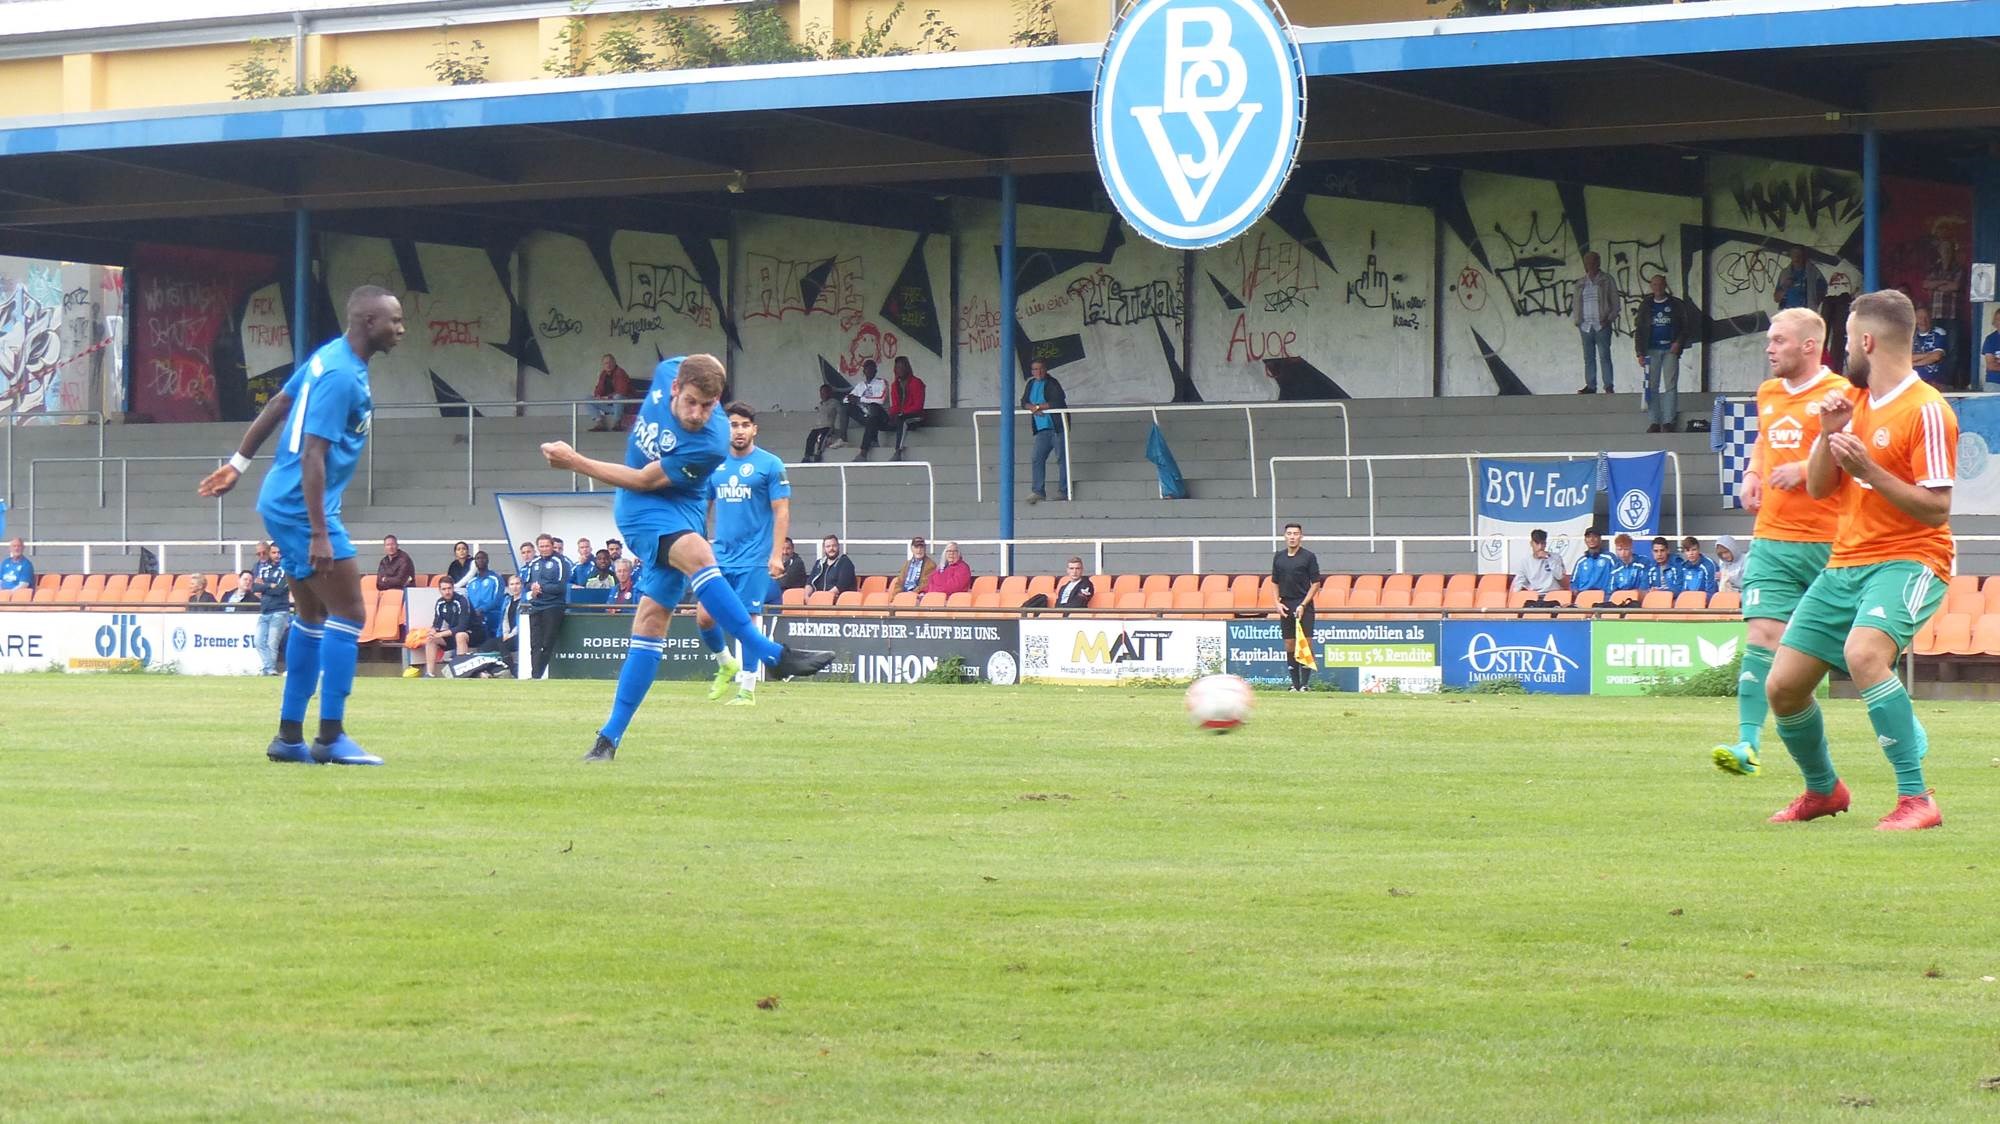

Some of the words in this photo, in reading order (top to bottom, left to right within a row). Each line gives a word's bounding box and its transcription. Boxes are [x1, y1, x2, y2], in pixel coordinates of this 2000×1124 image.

[1768, 430, 1803, 441] EWW
[717, 487, 751, 499] UNION
[1486, 466, 1589, 508] BSV-Fans
[194, 634, 239, 648] Bremer
[788, 623, 841, 637] BREMER
[842, 624, 881, 638] CRAFT
[881, 624, 908, 638] BIER
[916, 623, 953, 640] LÄUFT
[954, 627, 973, 640] BEI
[975, 627, 1001, 641] UNS.
[1405, 626, 1425, 640] als
[582, 638, 633, 649] ROBER
[1071, 630, 1173, 664] MATT
[1605, 638, 1690, 667] erima
[674, 653, 699, 661] SEIT
[1328, 648, 1345, 663] bis
[1347, 651, 1362, 663] zu
[1365, 649, 1384, 666] 5%
[1385, 648, 1433, 663] Rendite
[1468, 633, 1566, 673] OSTRA
[858, 654, 938, 684] UNION
